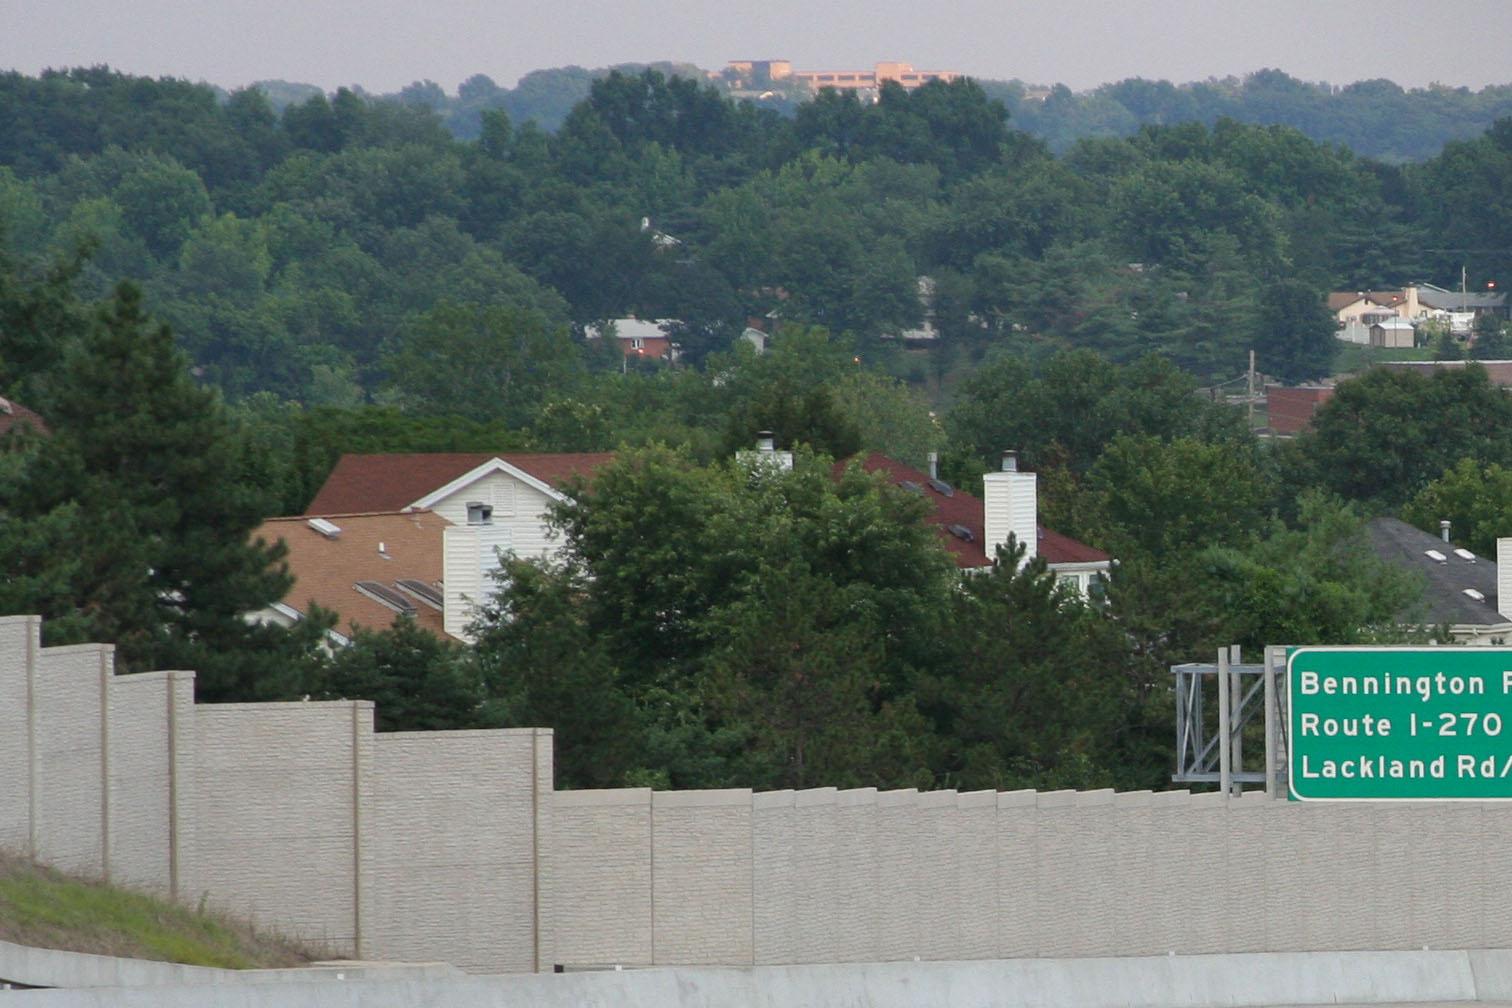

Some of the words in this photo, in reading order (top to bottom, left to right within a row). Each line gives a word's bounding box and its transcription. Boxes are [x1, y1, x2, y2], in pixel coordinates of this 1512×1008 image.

[1301, 671, 1484, 702] Bennington
[1301, 713, 1391, 736] Route
[1410, 713, 1502, 737] I-270
[1302, 755, 1445, 778] Lackland
